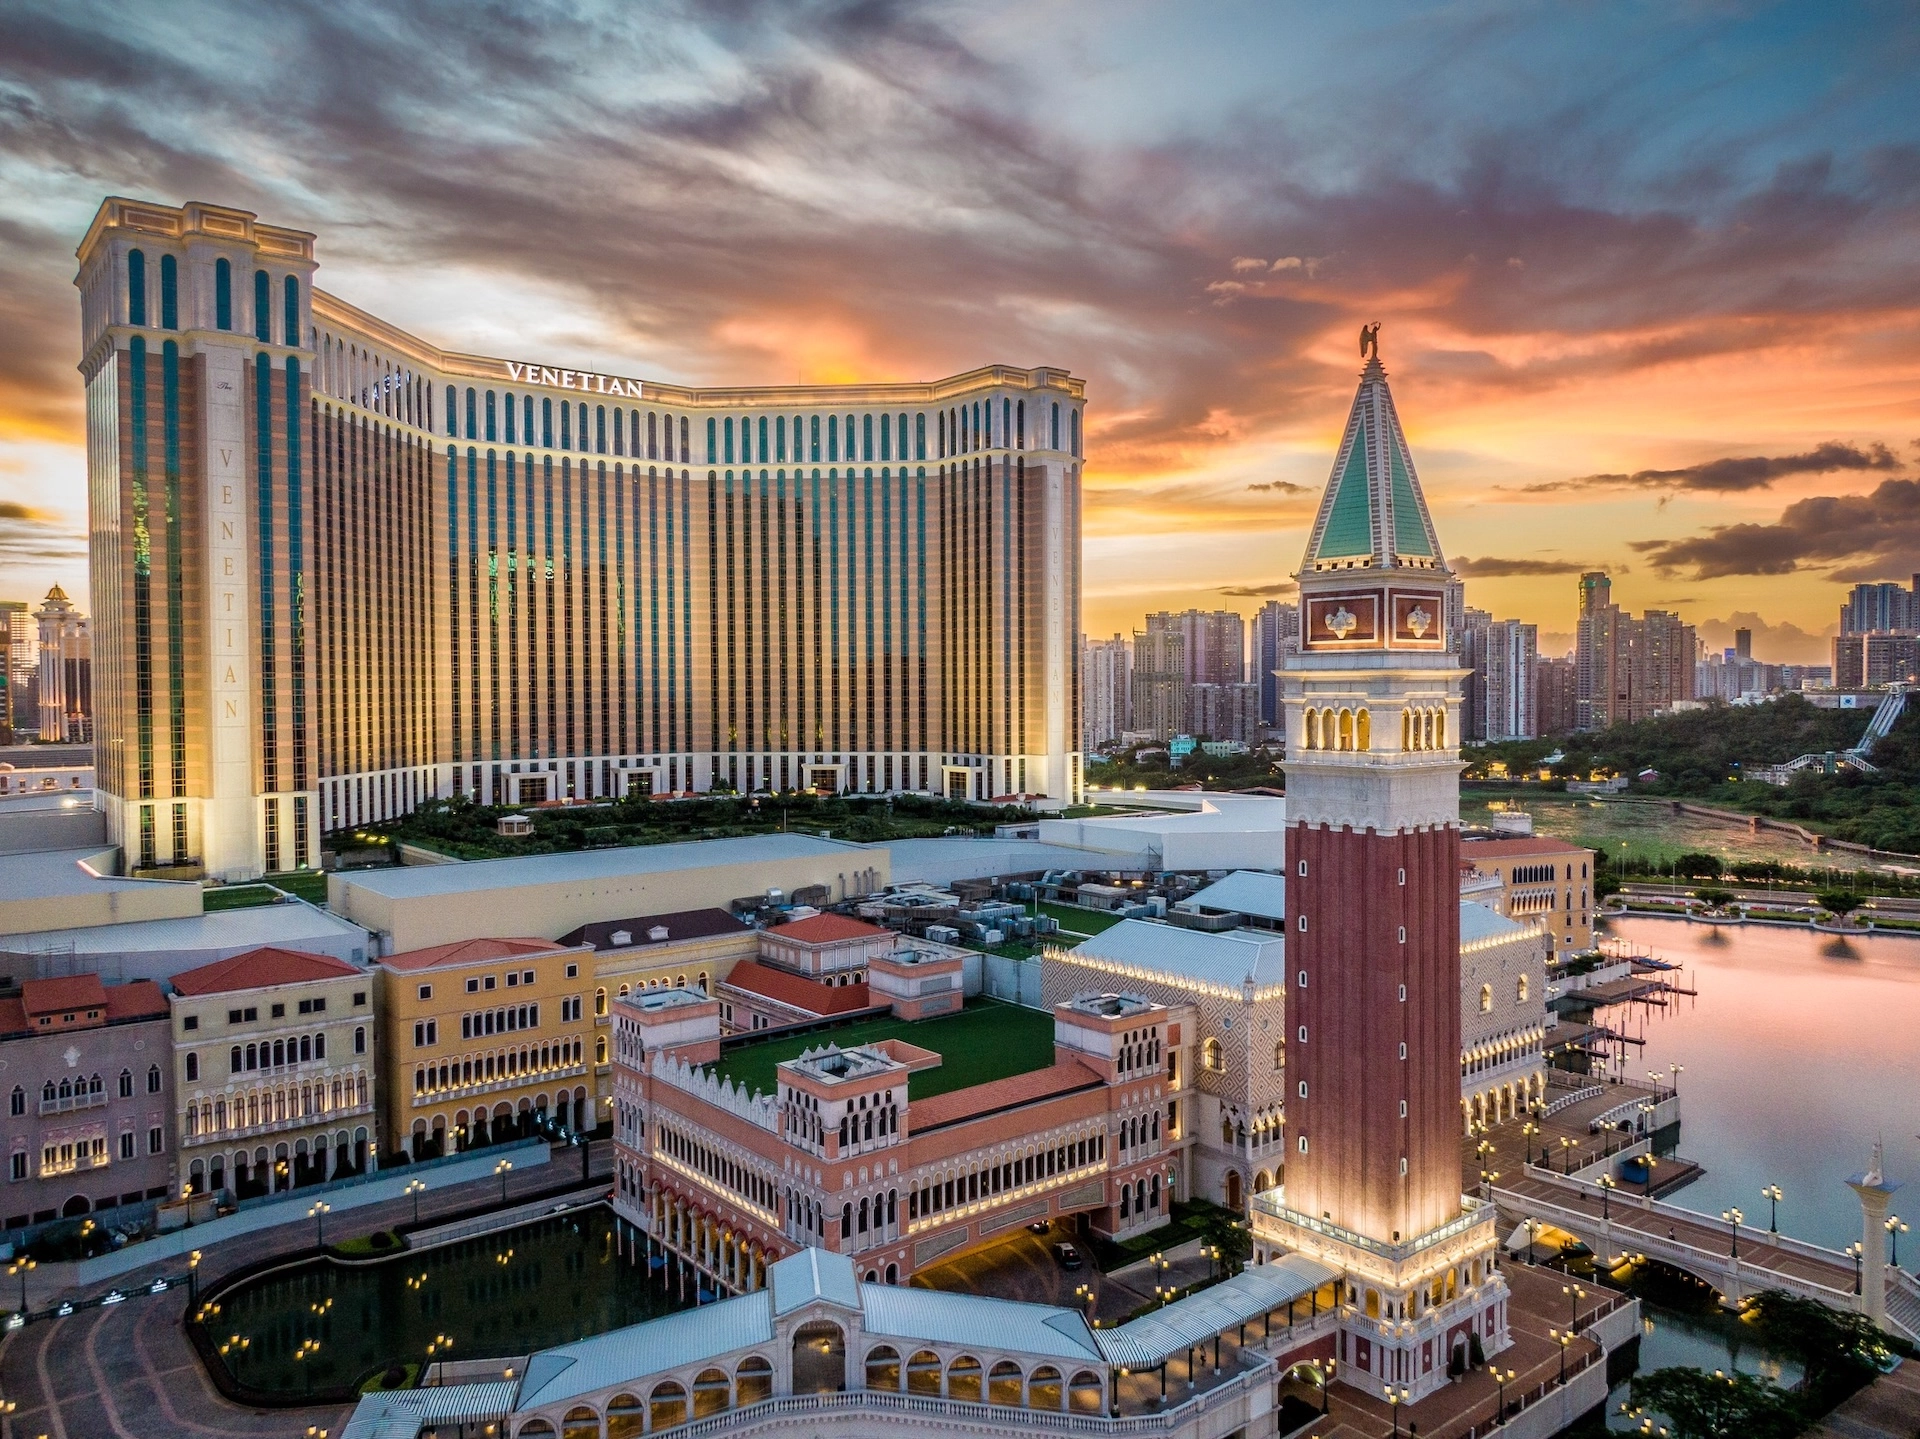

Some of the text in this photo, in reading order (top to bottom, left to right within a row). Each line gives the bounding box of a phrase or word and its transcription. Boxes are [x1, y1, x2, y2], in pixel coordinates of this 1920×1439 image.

[504, 361, 644, 398] VENETIAN
[219, 448, 238, 719] VENETIAN
[1052, 527, 1060, 704] VENETIAN
